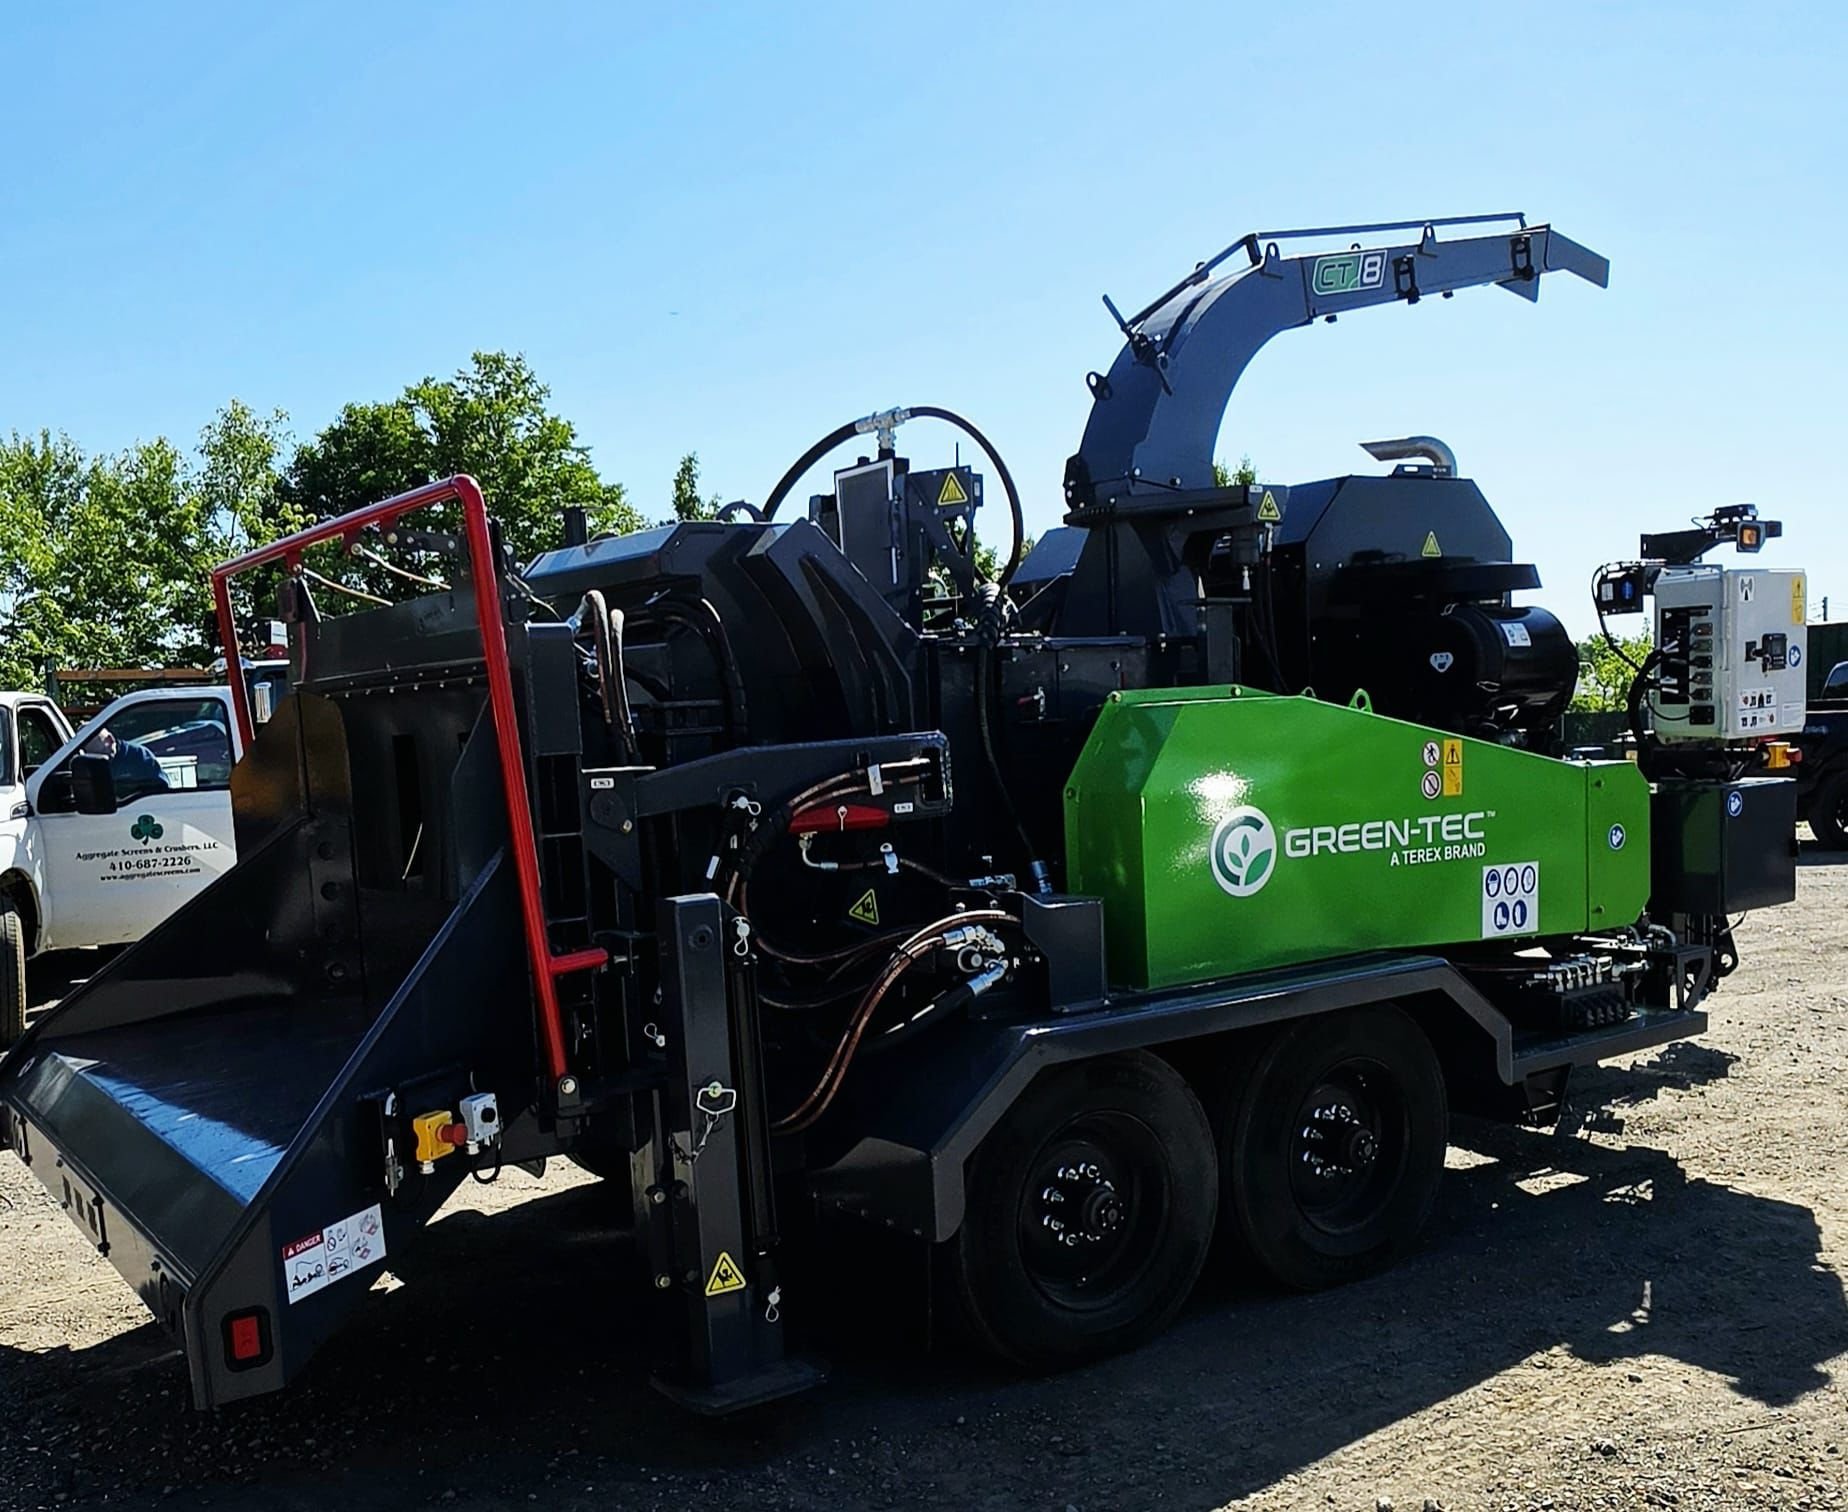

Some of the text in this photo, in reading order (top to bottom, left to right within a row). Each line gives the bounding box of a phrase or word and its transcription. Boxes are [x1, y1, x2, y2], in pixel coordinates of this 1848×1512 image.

[1285, 811, 1485, 858] GREEN-TEC
[76, 850, 119, 861] Aggregate
[121, 848, 153, 856] Screens
[203, 842, 218, 850] LLC
[1390, 842, 1486, 867] A TEREX BRAND
[109, 856, 191, 871] 410-687-2226
[100, 868, 201, 881] www.aggregatescreens.com
